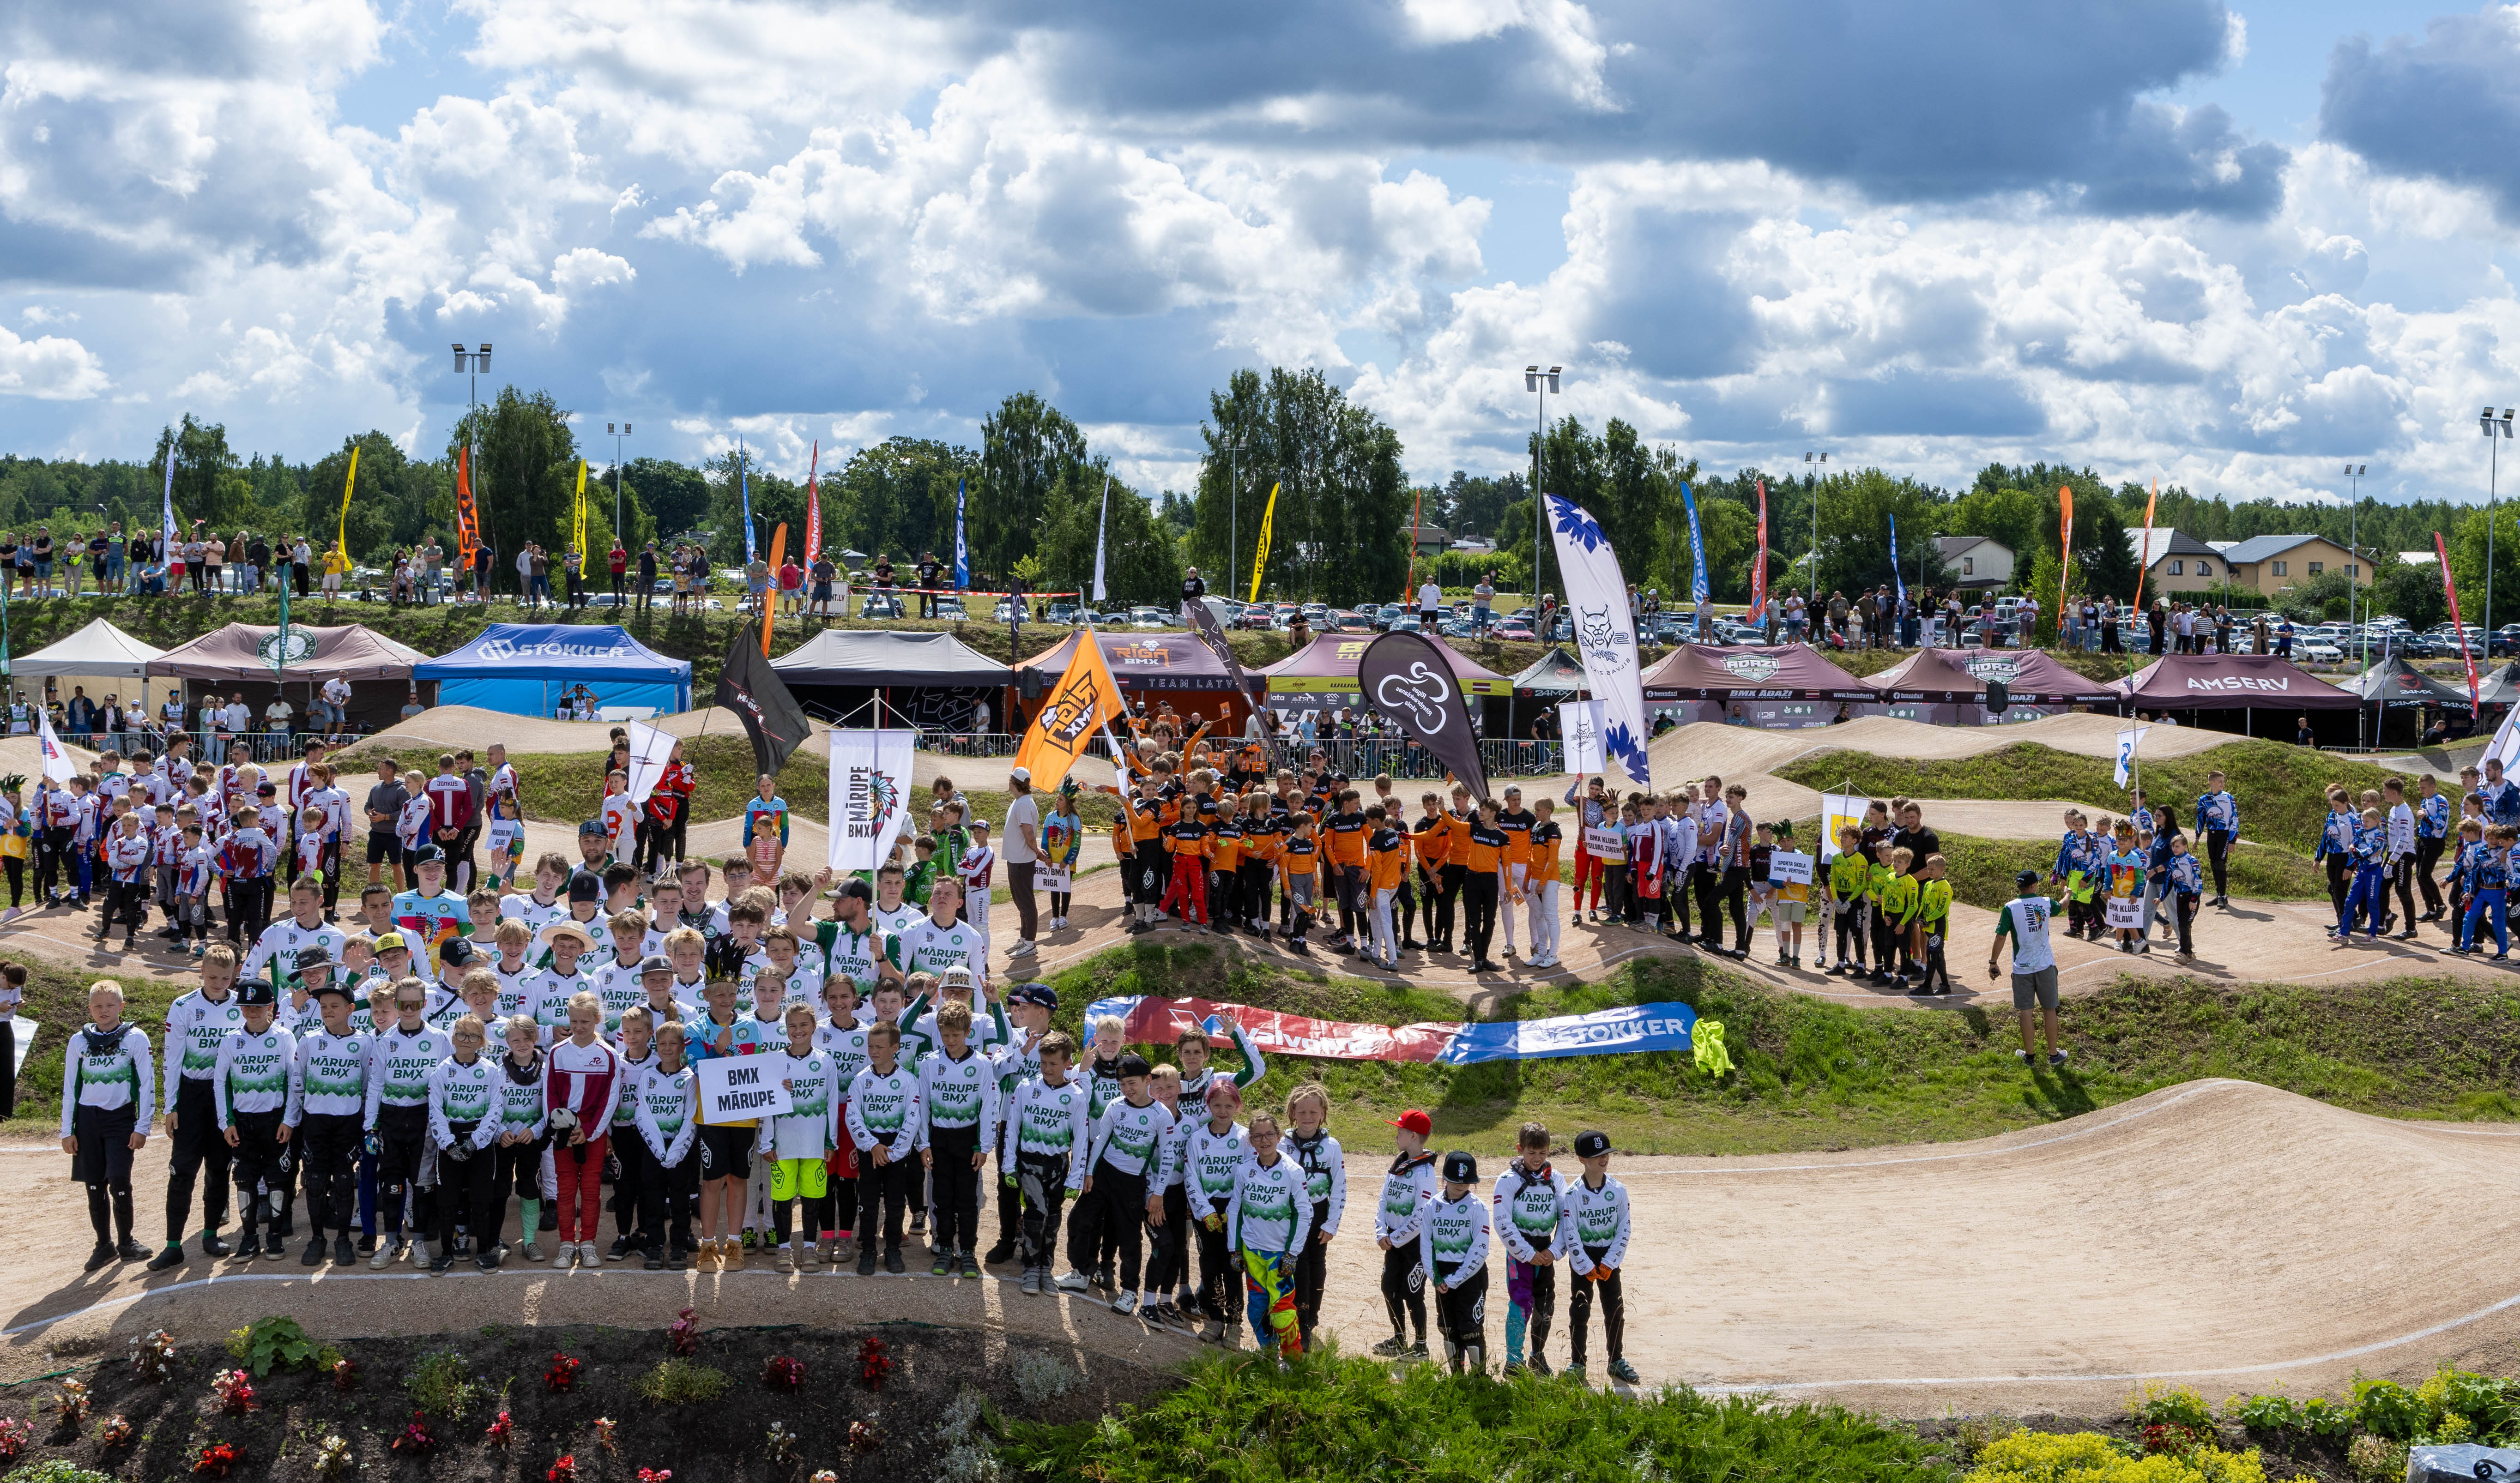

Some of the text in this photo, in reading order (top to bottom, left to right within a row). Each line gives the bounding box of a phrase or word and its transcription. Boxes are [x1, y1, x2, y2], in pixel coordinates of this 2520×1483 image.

[810, 491, 819, 555] Valvoline
[516, 643, 625, 658] STOKKER
[1112, 647, 1170, 668] RIGA
[1149, 678, 1245, 688] TEAM LATV
[2187, 676, 2288, 691] AMSERV
[2441, 701, 2474, 710] 24MX
[846, 766, 869, 822] MĀRUPE
[848, 824, 870, 838] BMX
[1602, 837, 1618, 845] KLUBS
[1588, 843, 1604, 851] SILVAS
[1043, 878, 1058, 887] RIGA
[2109, 903, 2139, 912] BMX KLUBS
[2025, 903, 2034, 926] MĀRUPE
[2112, 913, 2133, 923] TĀLAVA
[918, 946, 967, 960] MĀRUPE
[929, 956, 957, 967] BMX
[370, 967, 388, 976] BM
[841, 965, 864, 976] BMX
[780, 994, 806, 1004] RUPE
[607, 1001, 635, 1012] BMX
[1557, 1018, 1688, 1044] STOKKER
[199, 1038, 221, 1049] BM
[89, 1057, 115, 1067] BMX
[233, 1054, 281, 1064] MĀRUPE
[310, 1055, 360, 1068] MĀRUPE
[386, 1057, 437, 1068] MĀRUPE
[241, 1065, 269, 1075] BMX
[320, 1068, 350, 1079] BMX
[393, 1069, 424, 1081] BMX
[727, 1067, 760, 1086] BMX
[1190, 1075, 1204, 1089] LEATT
[932, 1081, 980, 1093] MĀRUPE
[1094, 1081, 1121, 1091] MĀRU
[451, 1093, 478, 1103] BMX
[717, 1090, 776, 1112] MĀRUPE
[942, 1092, 968, 1104] BMX
[1103, 1091, 1122, 1101] BM
[508, 1097, 534, 1107] BMX
[651, 1105, 677, 1116] BMX
[868, 1103, 894, 1114] BMX
[1024, 1105, 1072, 1120] MĀRUPE
[1033, 1115, 1060, 1128] BMX
[1114, 1124, 1149, 1138] MĀRUPE
[1119, 1132, 1138, 1142] BMX
[1197, 1155, 1244, 1165] MĀRUPE
[1206, 1165, 1234, 1176] BMX
[1244, 1182, 1287, 1194] MĀRUPE
[1250, 1194, 1275, 1204] BMX
[1387, 1188, 1403, 1200] BMX
[1526, 1203, 1553, 1214] BMX
[1432, 1217, 1471, 1228] MĀRUPE
[1589, 1217, 1613, 1228] BMX
[1437, 1227, 1461, 1238] BMX
